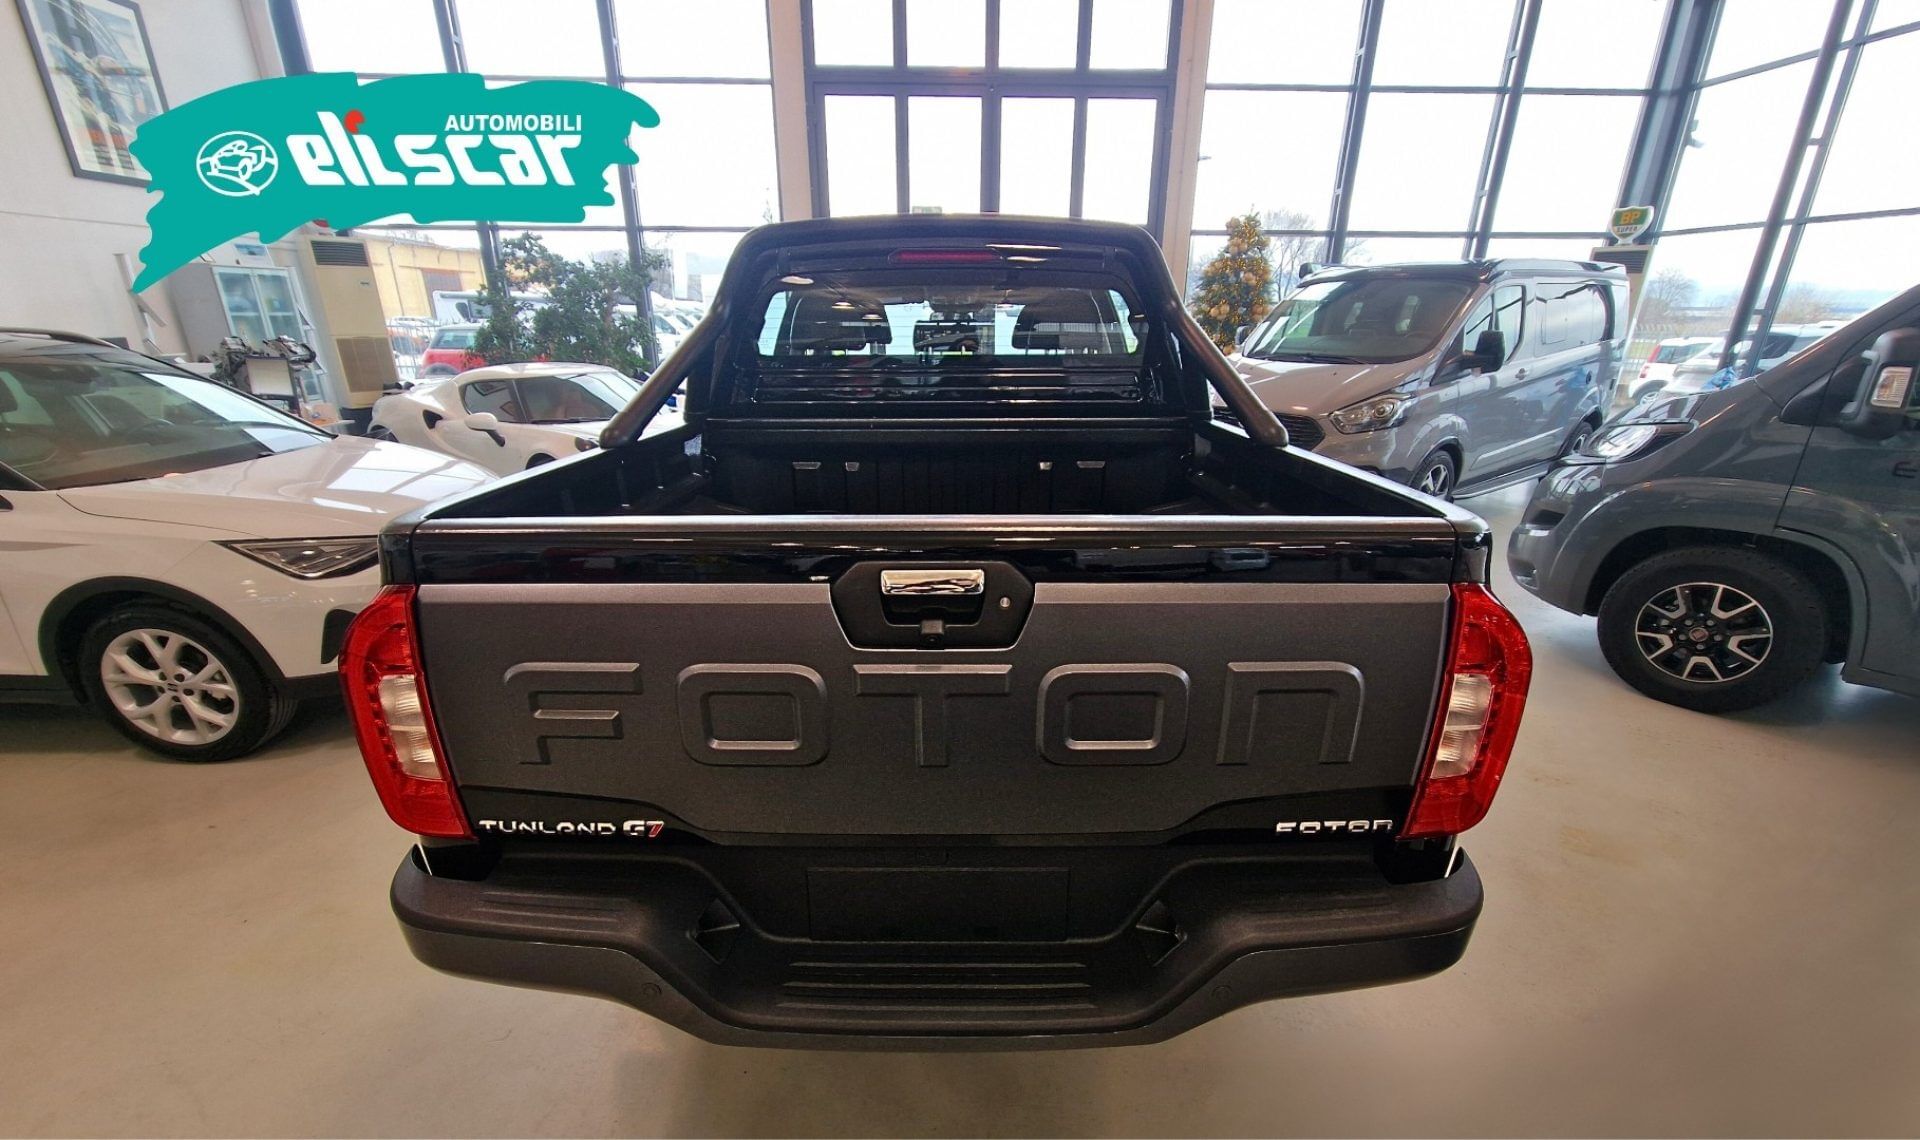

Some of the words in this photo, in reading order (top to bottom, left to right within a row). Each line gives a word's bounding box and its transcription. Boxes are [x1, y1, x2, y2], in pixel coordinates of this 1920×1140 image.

[1620, 212, 1641, 224] BP
[502, 661, 1365, 767] FOTON
[478, 819, 616, 836] TUNLAND
[622, 819, 665, 838] G7
[1275, 819, 1393, 835] FOTON
